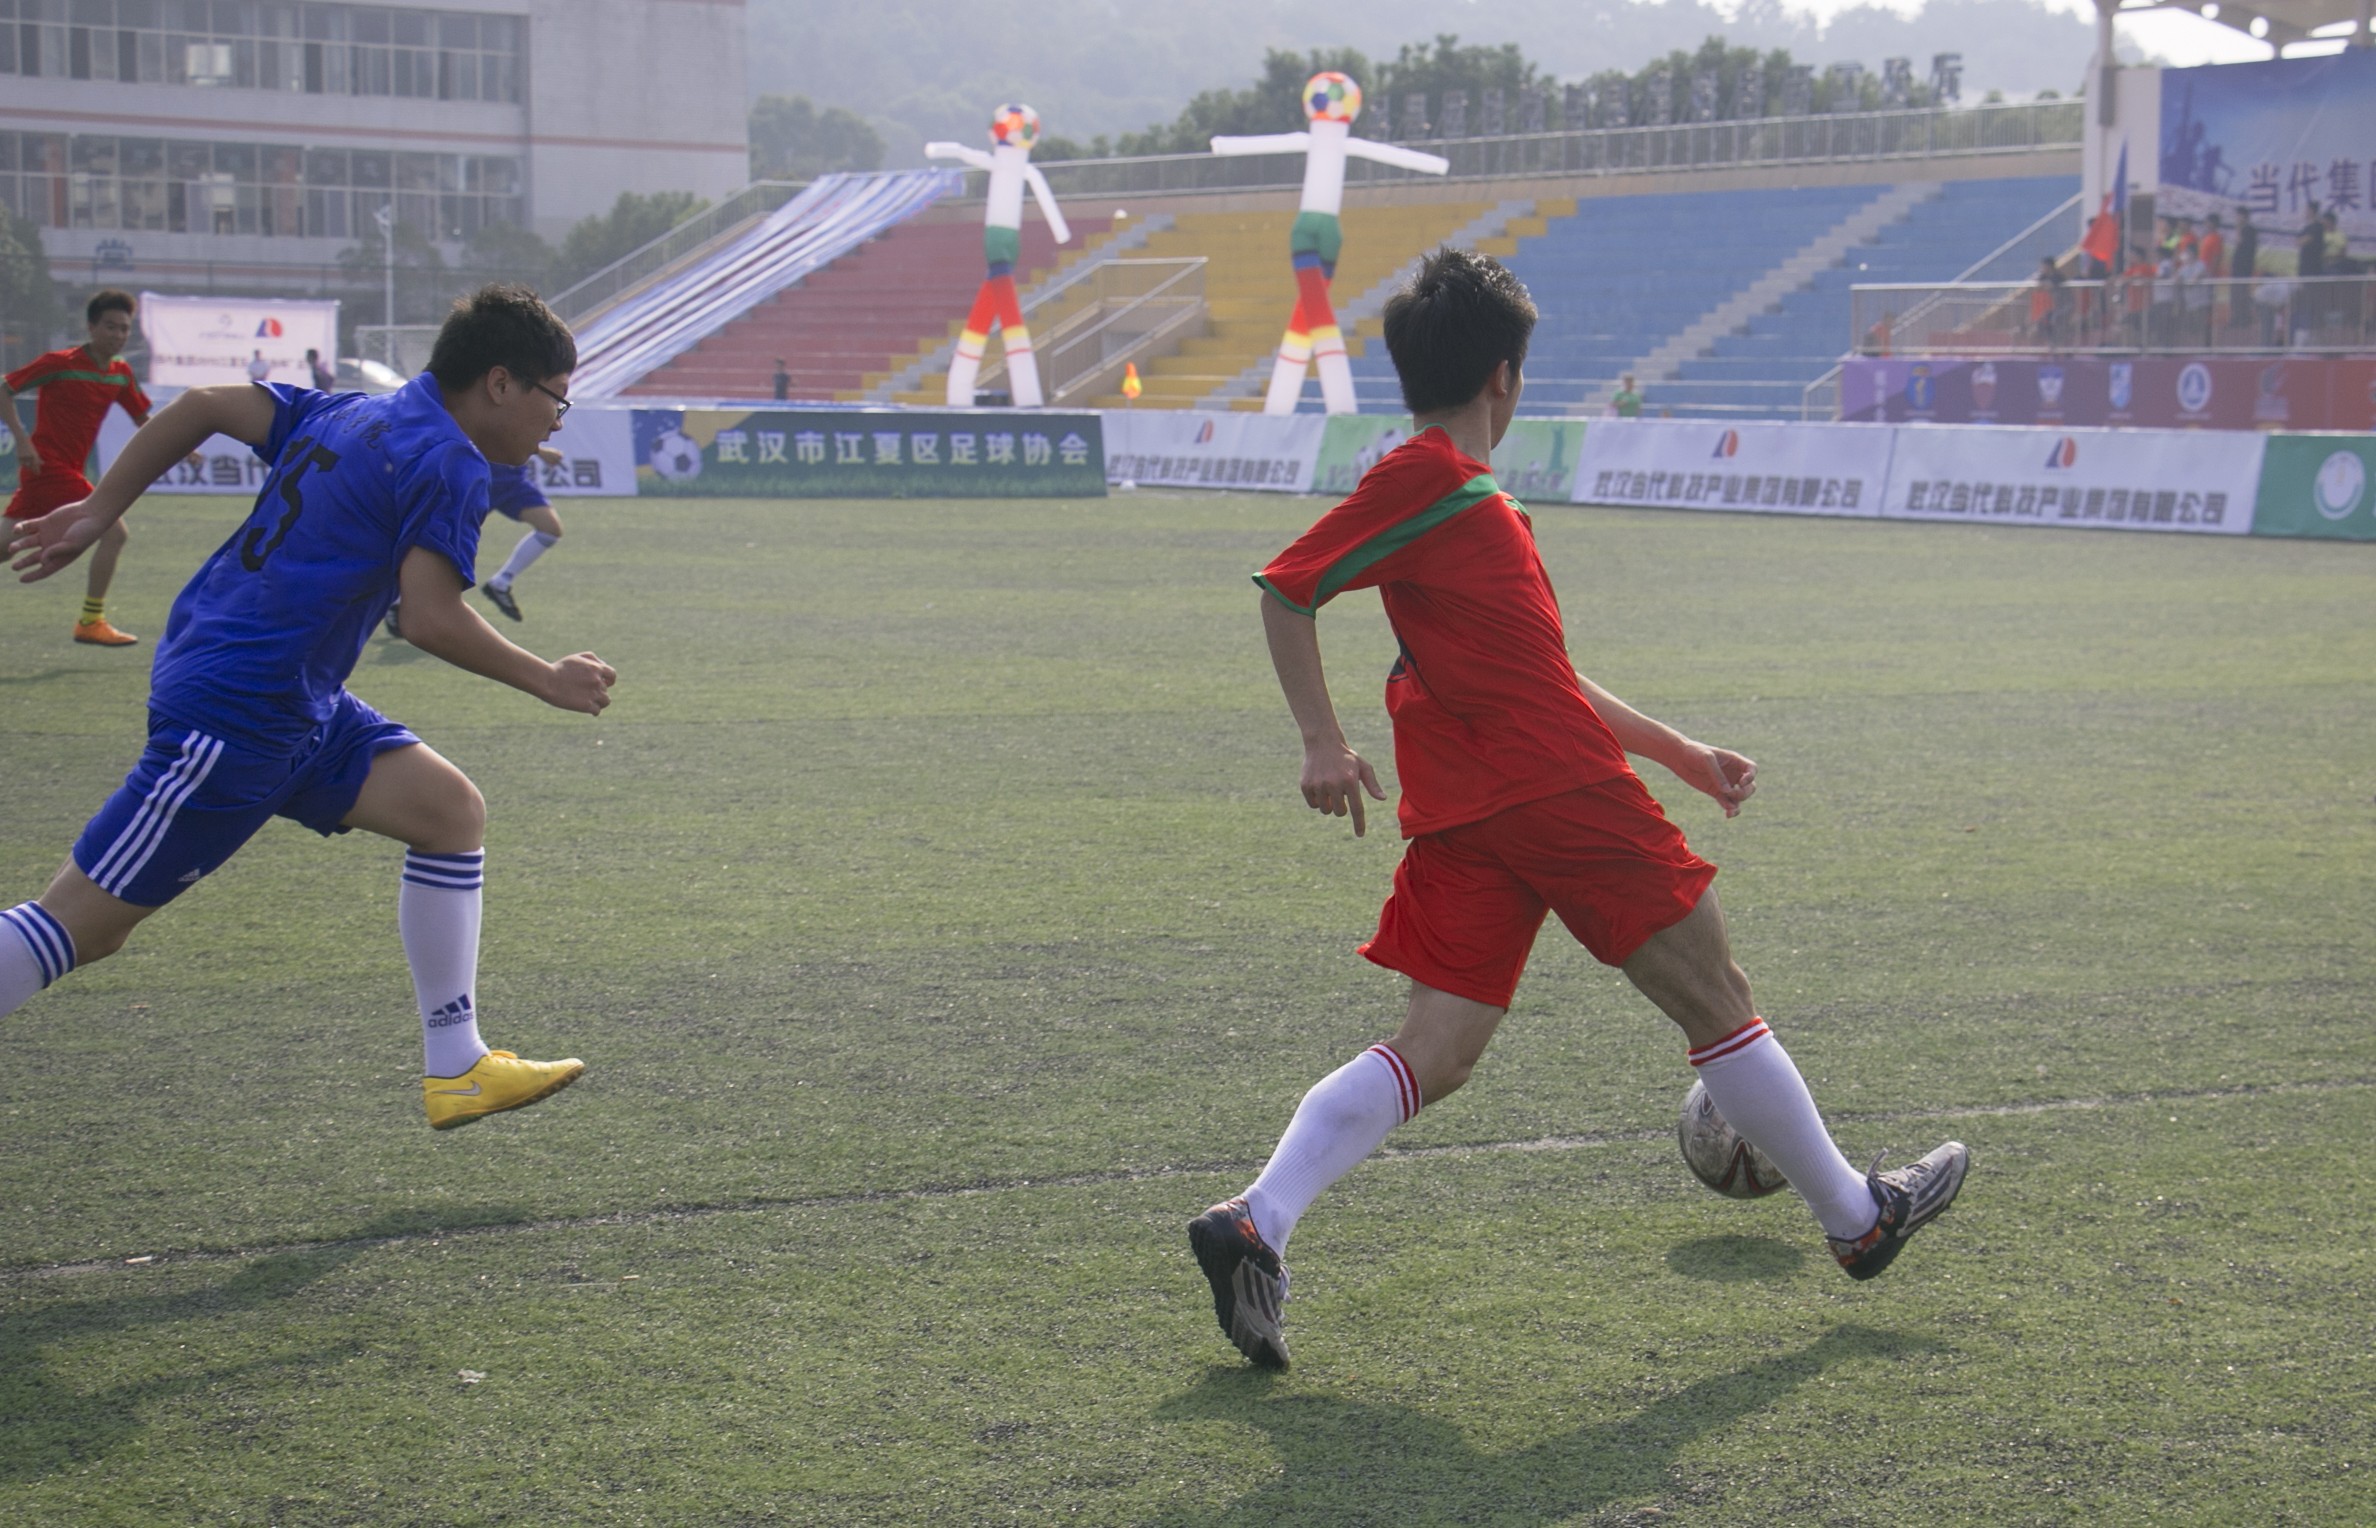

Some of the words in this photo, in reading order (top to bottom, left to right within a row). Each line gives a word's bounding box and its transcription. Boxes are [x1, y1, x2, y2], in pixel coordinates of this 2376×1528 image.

[715, 429, 1089, 466] 武汉市江夏区足球协会
[1905, 481, 2226, 525] 武汉当代科技产业集团有限公司
[428, 1011, 474, 1028] adidas
